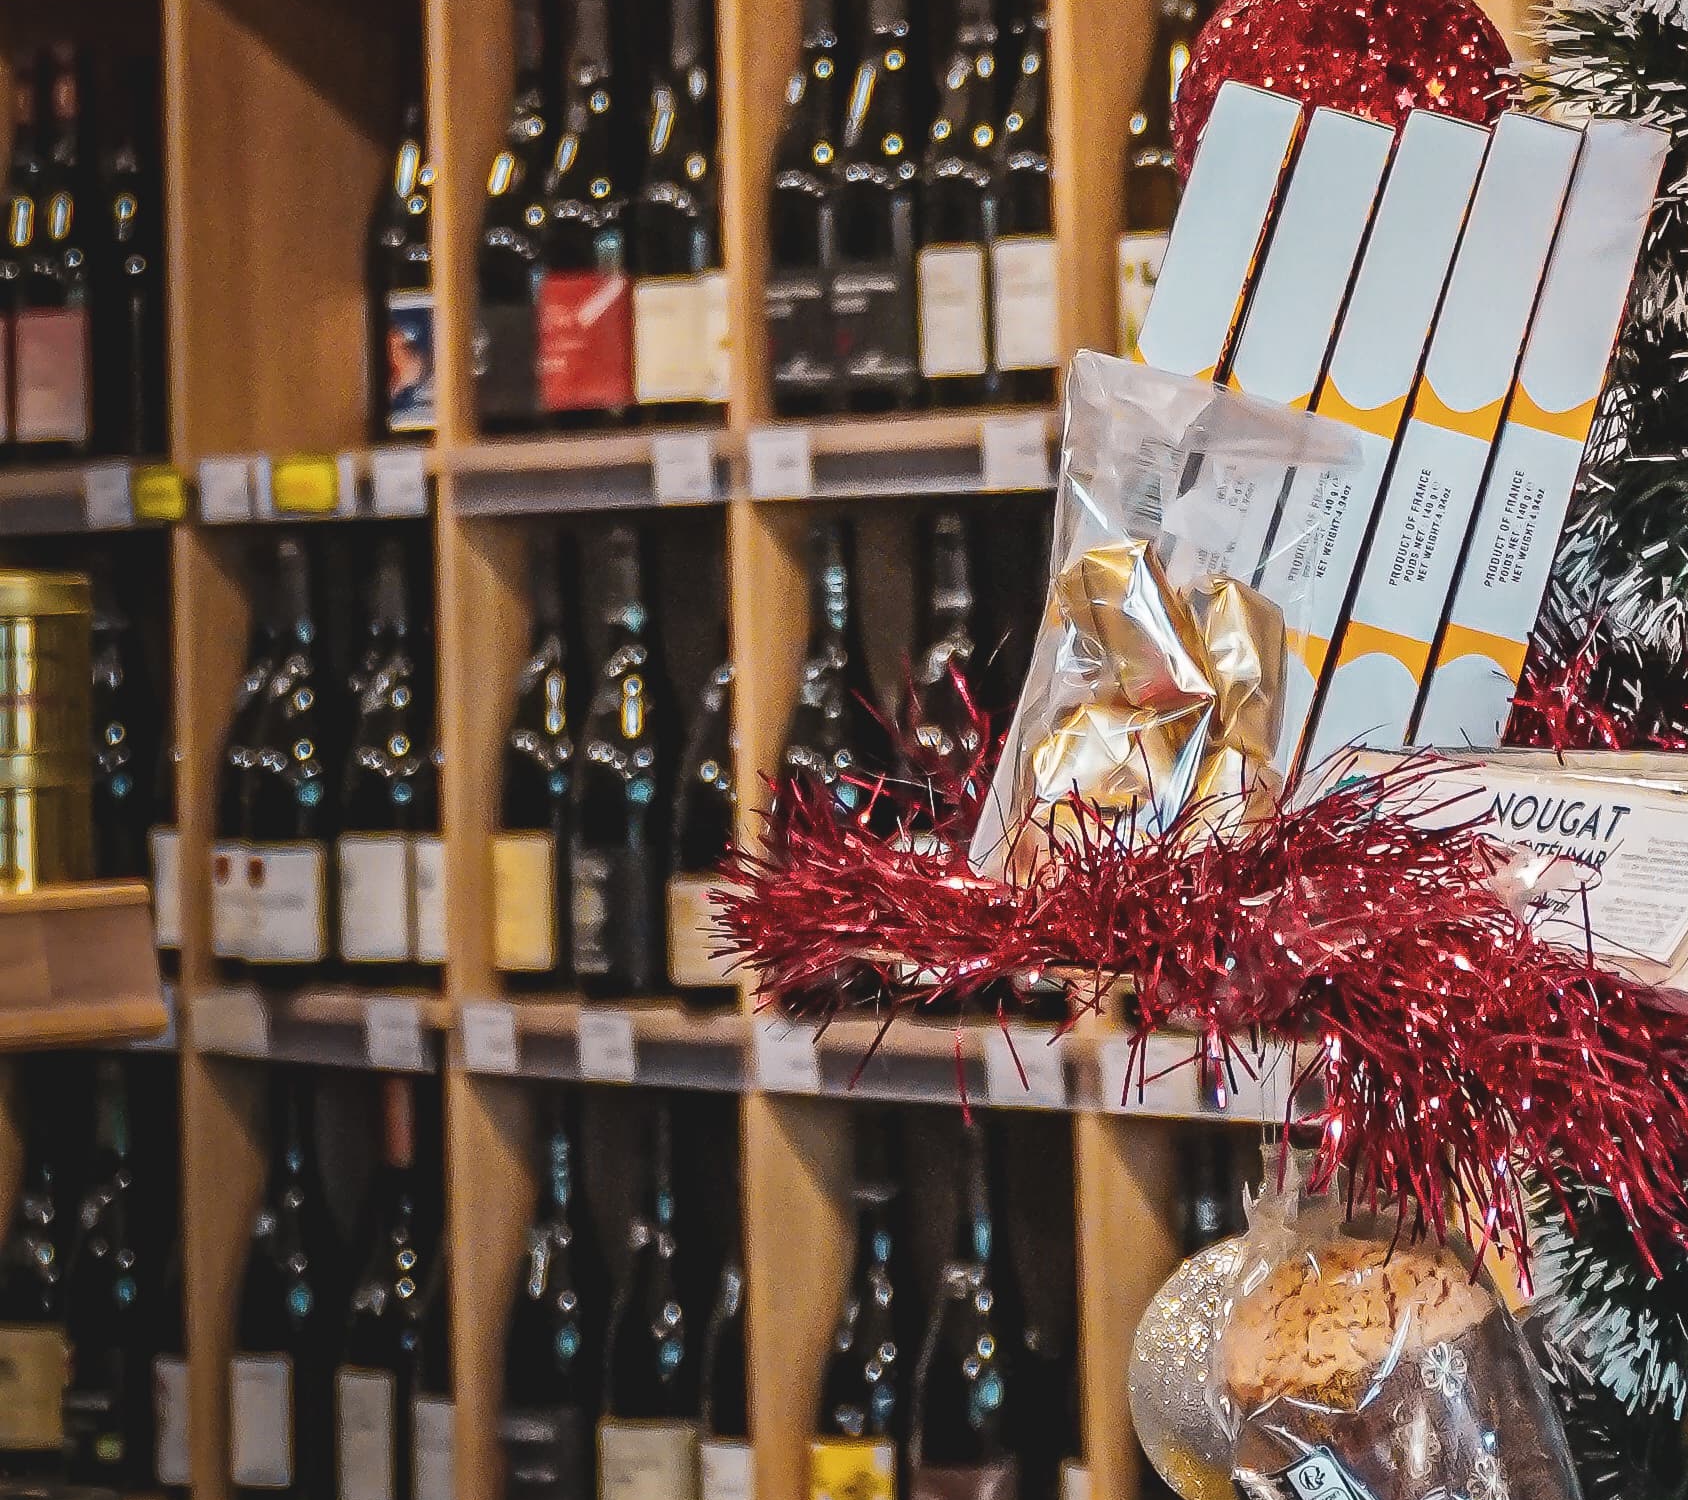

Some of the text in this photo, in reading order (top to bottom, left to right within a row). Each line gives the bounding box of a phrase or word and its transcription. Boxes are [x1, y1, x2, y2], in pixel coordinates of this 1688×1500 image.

[1314, 518, 1342, 578] NET WEIGHT
[1387, 467, 1432, 586] PRODUCT OF FRANCE
[1402, 551, 1419, 582] POIDS
[1412, 530, 1426, 549] NET
[1421, 501, 1434, 519] 140
[1415, 521, 1441, 581] NET WEIGHT
[1481, 469, 1525, 587] PRODUCT OF FRANCE
[1497, 553, 1514, 582] POIDS
[1507, 531, 1520, 549] NET
[1510, 522, 1536, 582] NET WEIGHT
[1489, 791, 1632, 842] NOUGAT
